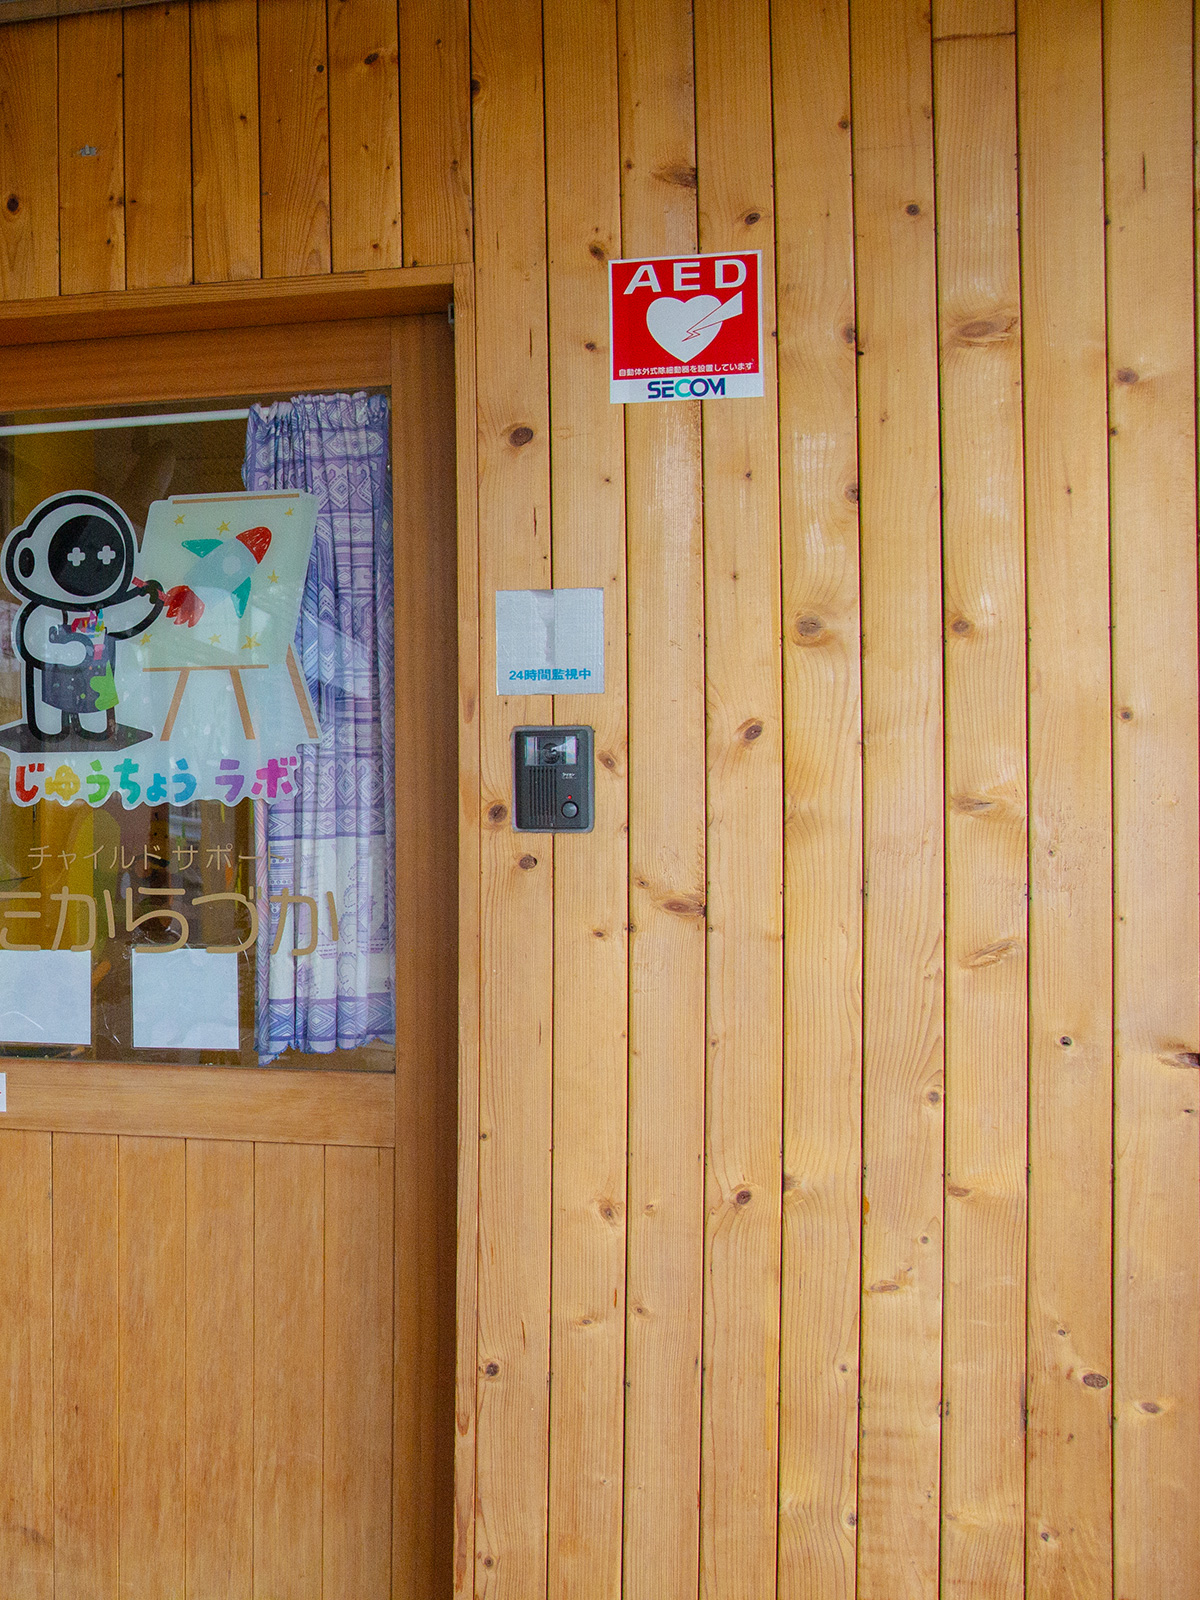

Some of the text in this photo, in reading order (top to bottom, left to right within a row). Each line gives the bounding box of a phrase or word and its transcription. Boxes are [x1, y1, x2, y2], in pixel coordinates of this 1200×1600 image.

[623, 259, 747, 295] AED
[618, 362, 753, 377] 自動体外式除細動器を設置しています
[647, 377, 726, 399] SECOM
[508, 668, 592, 682] 24時間監視中
[15, 755, 298, 804] じゅうちょう ラボ
[27, 842, 285, 871] チャイルドサポート
